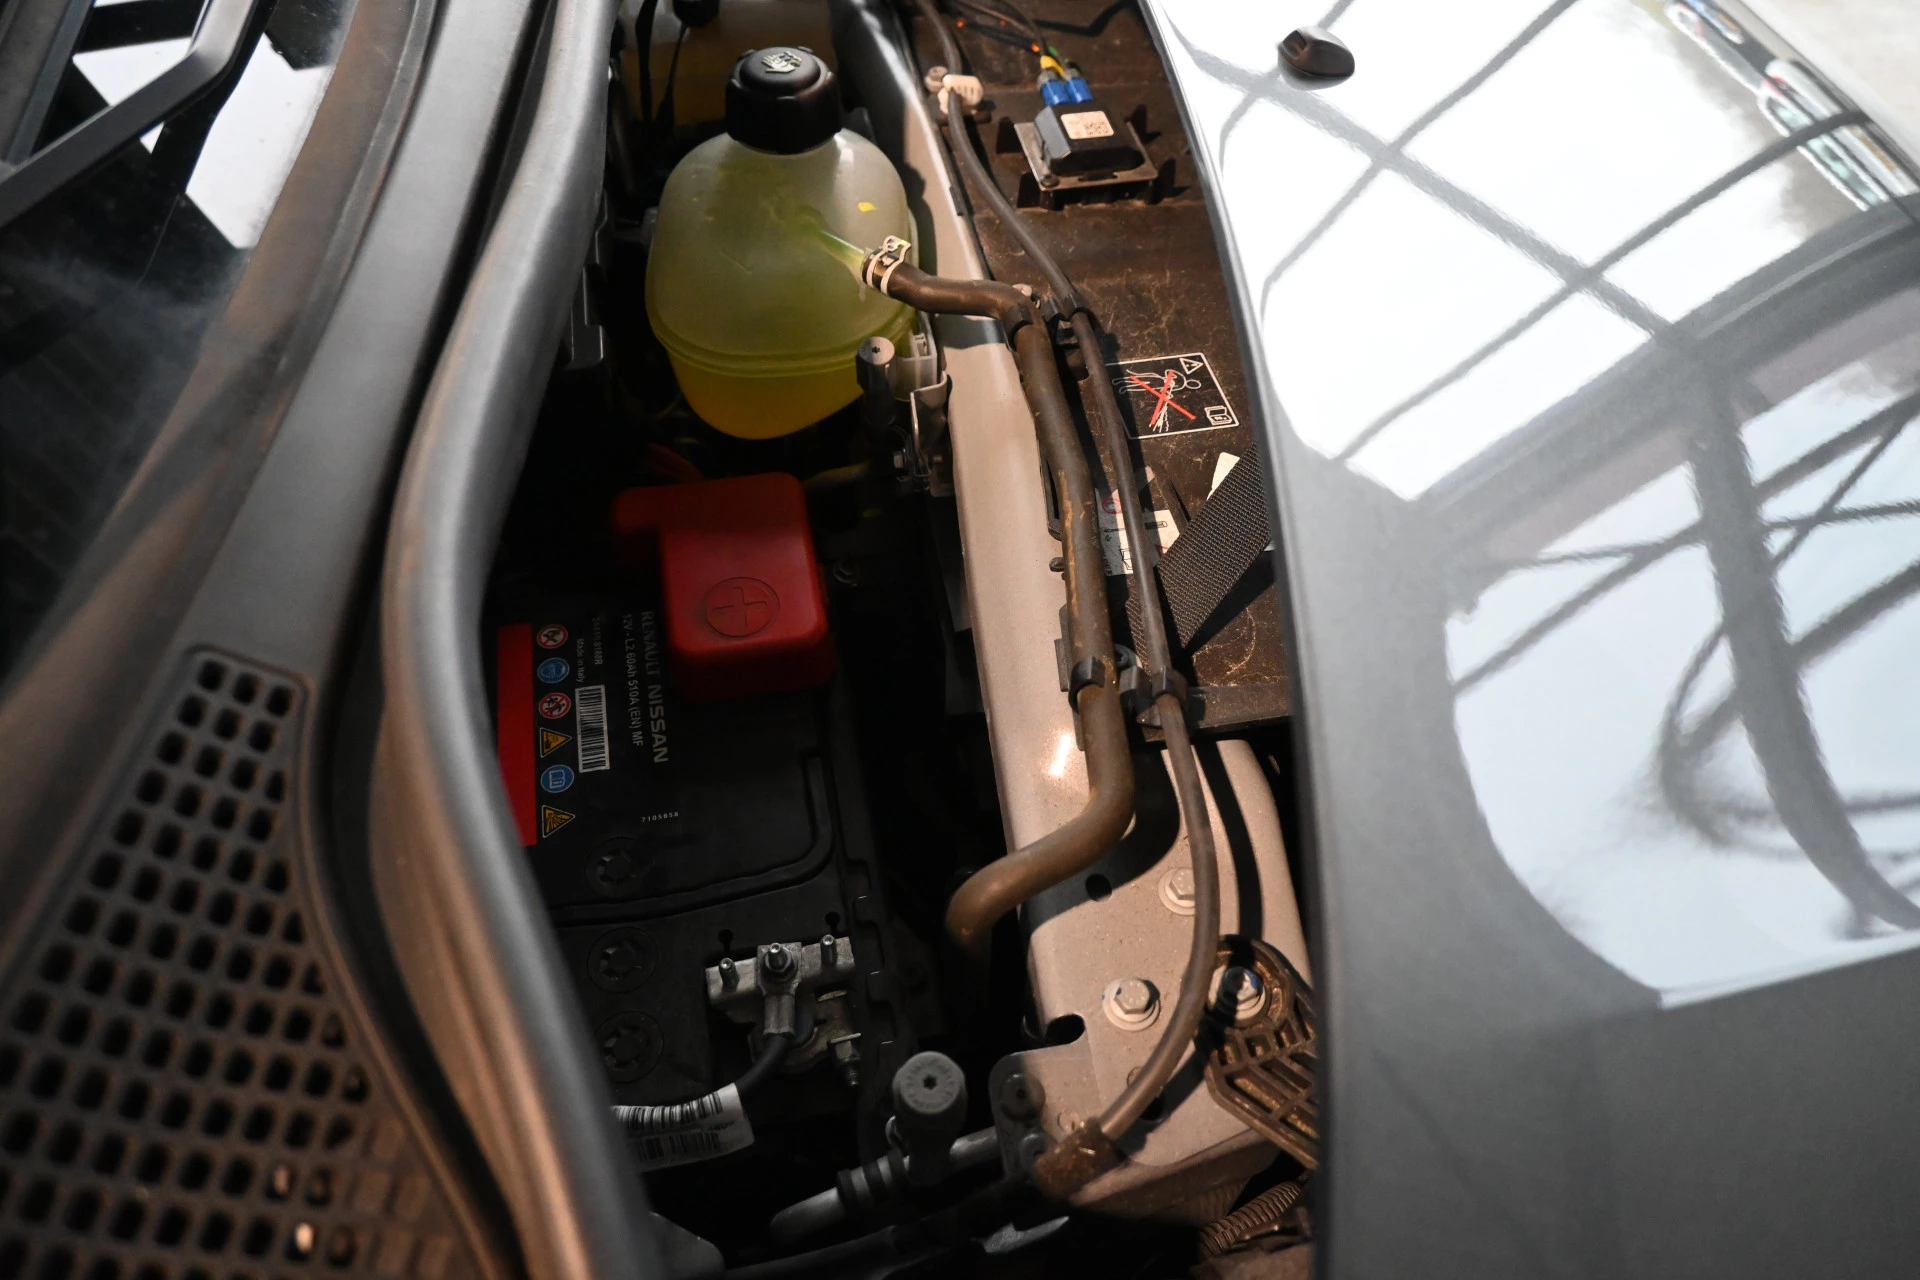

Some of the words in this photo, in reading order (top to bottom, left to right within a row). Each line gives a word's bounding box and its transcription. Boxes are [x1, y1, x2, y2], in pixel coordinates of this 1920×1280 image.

[623, 614, 633, 629] 12V
[576, 638, 585, 656] Made
[624, 639, 635, 650] L2
[641, 611, 660, 676] RENAULT
[576, 667, 586, 682] Italy
[626, 653, 637, 677] 60Ah
[628, 680, 639, 705] 510A
[628, 706, 641, 728] (EN)
[648, 684, 668, 763] NISSAN
[632, 731, 643, 746] MF
